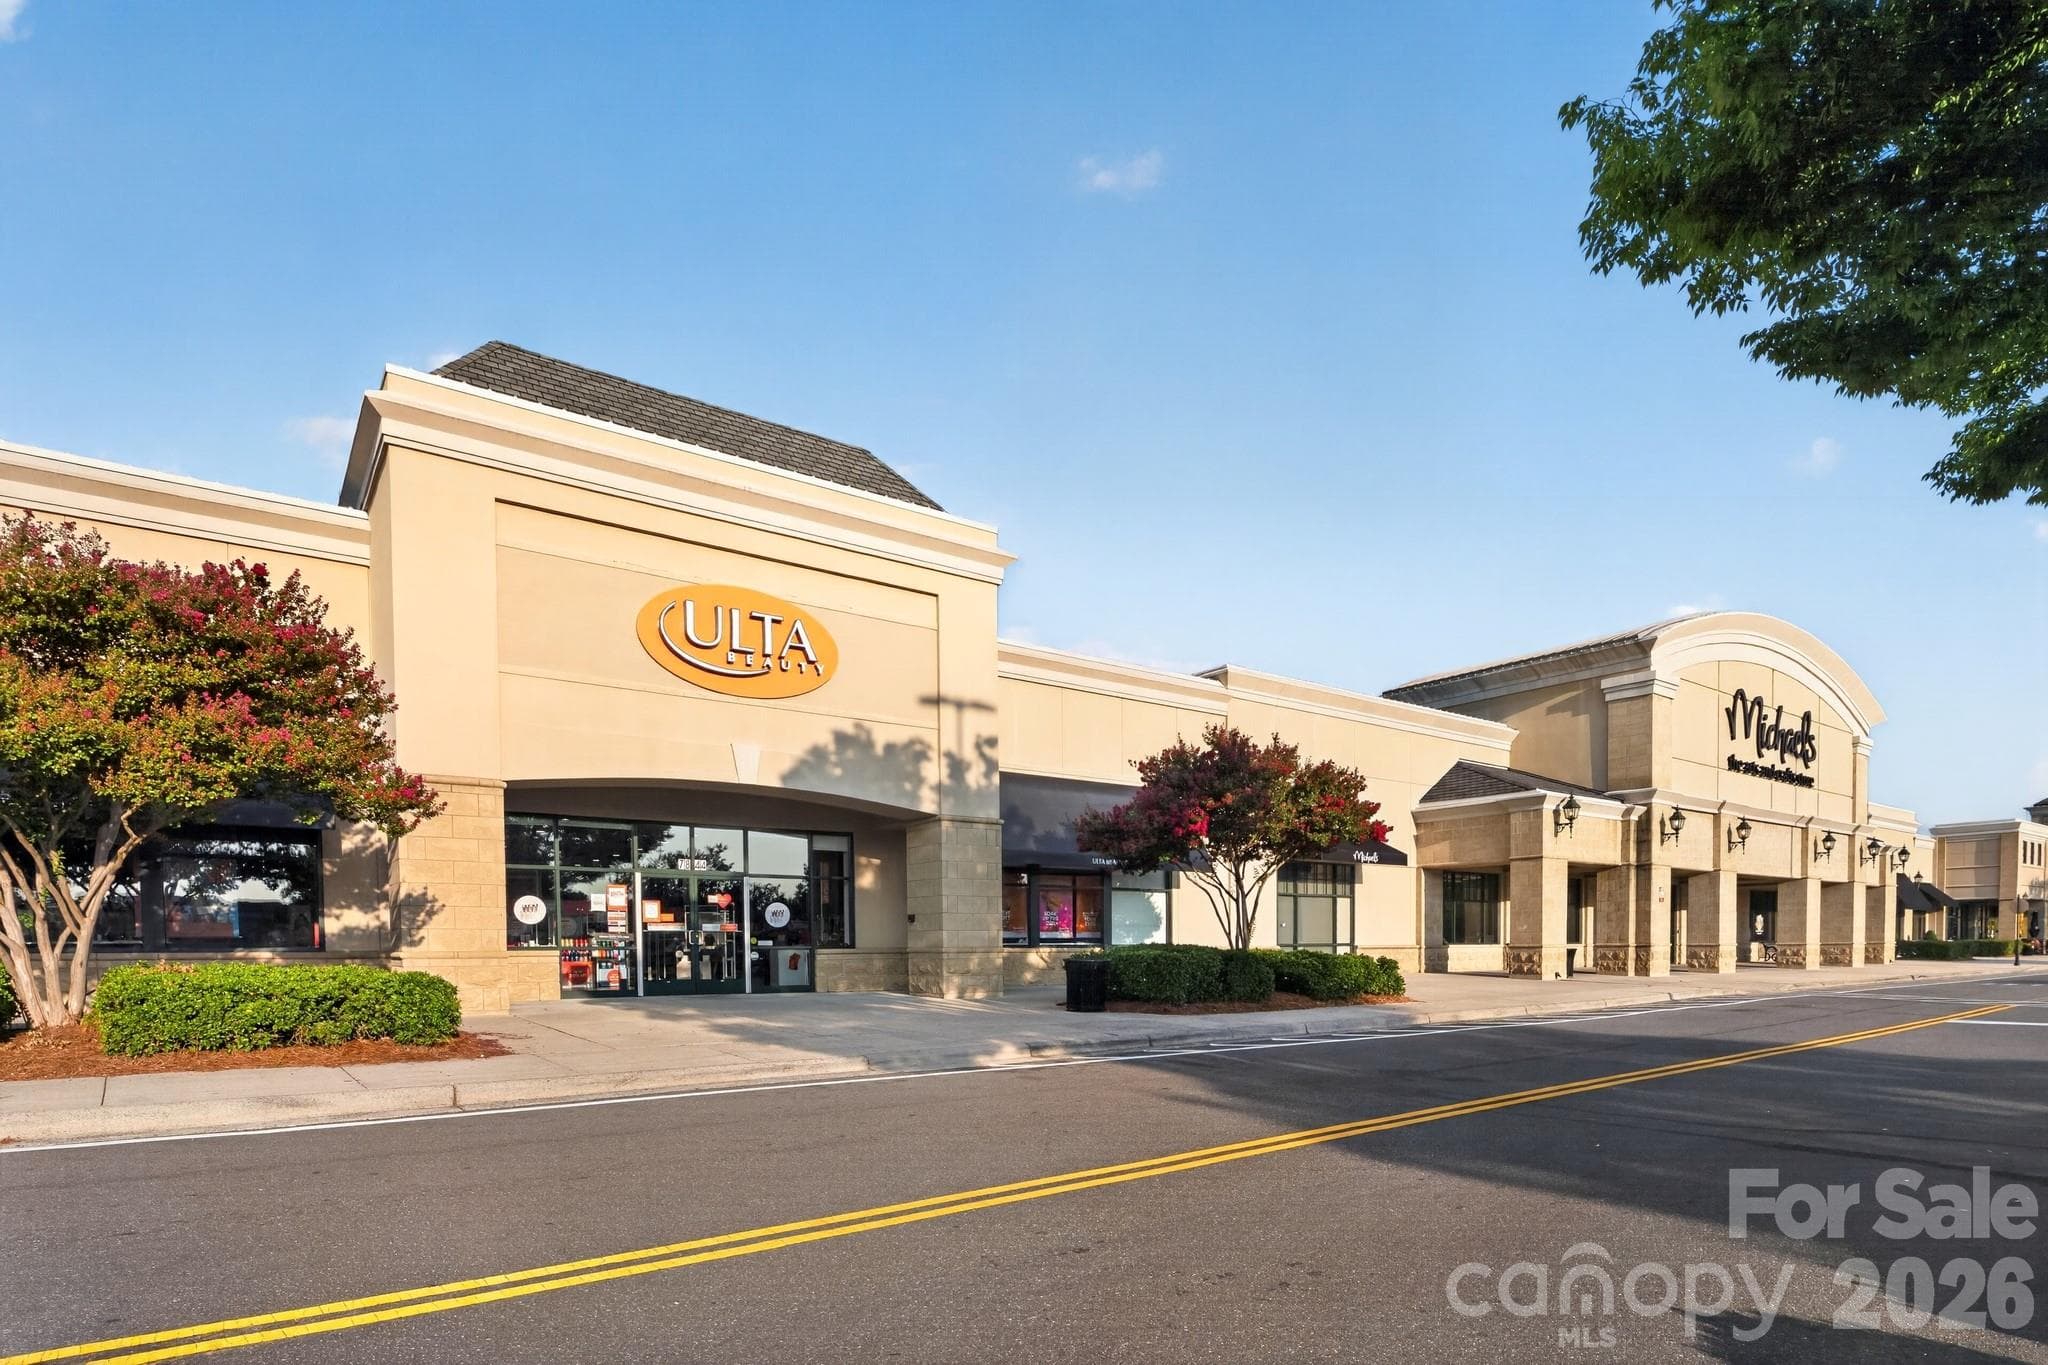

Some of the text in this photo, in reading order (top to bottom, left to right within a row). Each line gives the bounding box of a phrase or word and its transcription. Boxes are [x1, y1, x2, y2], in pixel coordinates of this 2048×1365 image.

[683, 600, 818, 664] ULTA
[726, 651, 825, 677] BEAUTY
[1725, 688, 1817, 770] Michaels
[1353, 850, 1379, 863] Michaels
